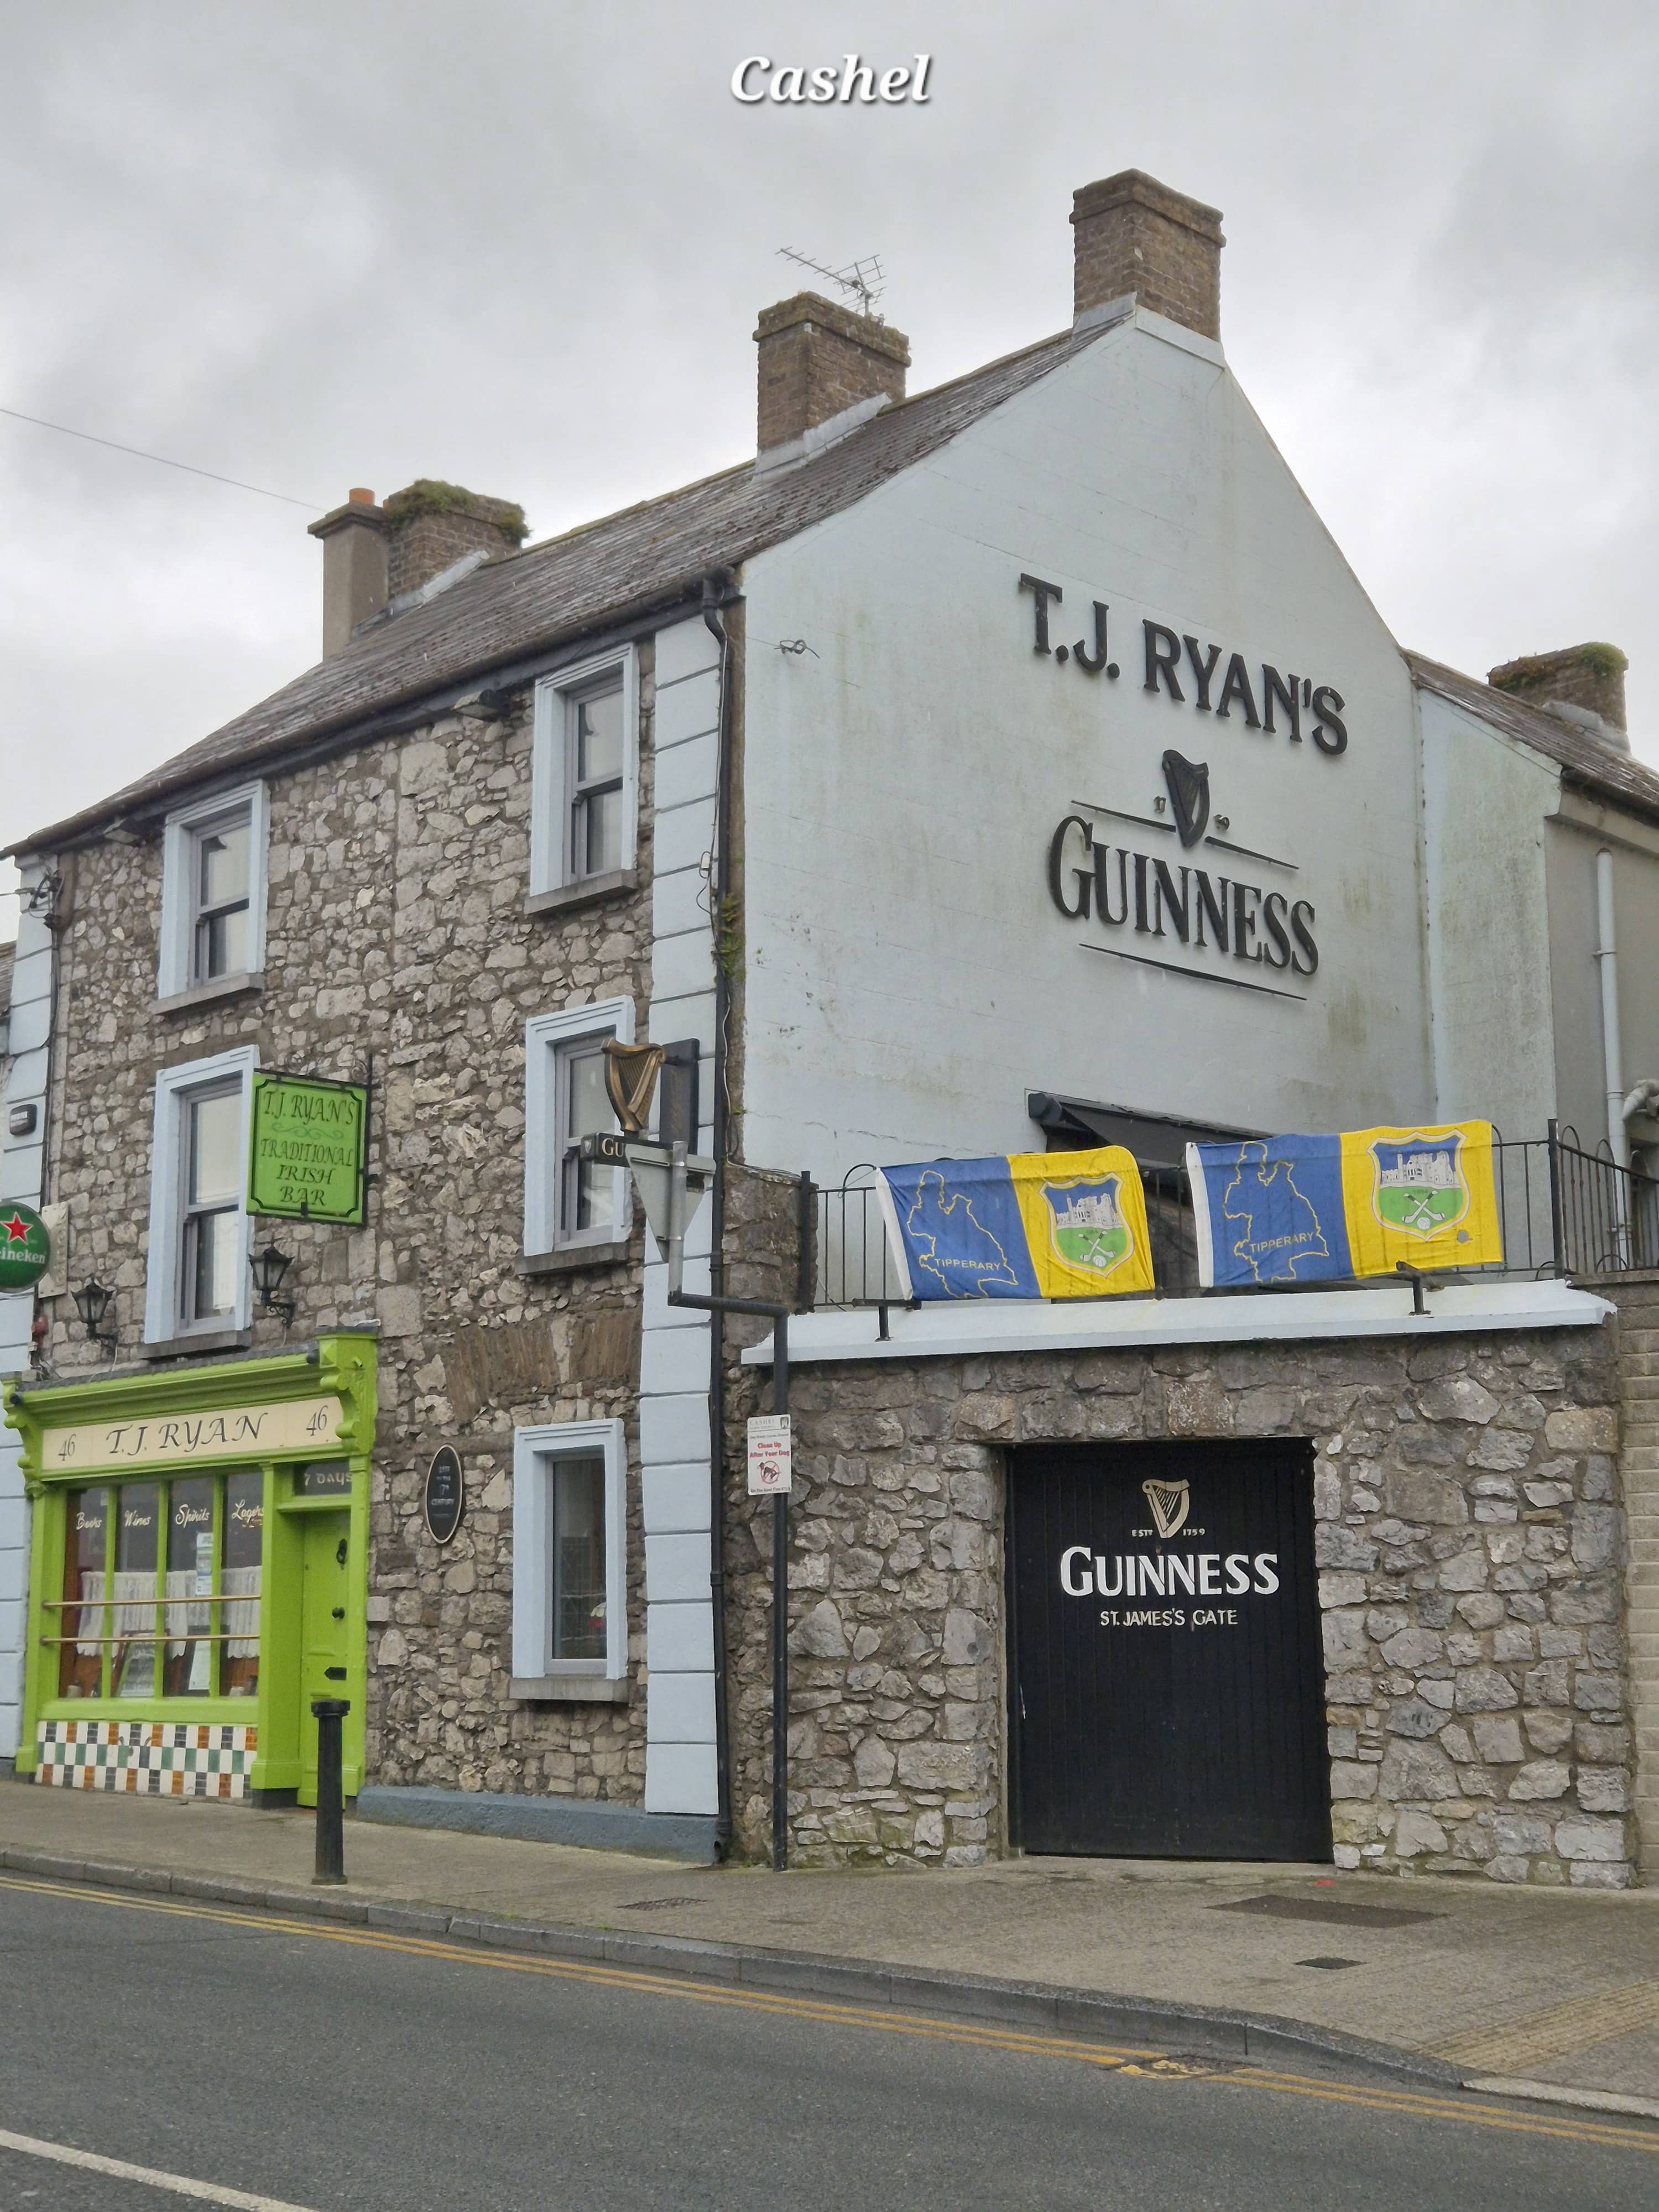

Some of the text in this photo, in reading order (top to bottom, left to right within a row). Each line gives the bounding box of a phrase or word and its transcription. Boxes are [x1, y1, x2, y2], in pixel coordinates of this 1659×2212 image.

[1019, 572, 1348, 756] T.J. RYAN'S
[1050, 815, 1319, 976] GUINNESS
[290, 1094, 356, 1125] RYAN'S
[260, 1138, 354, 1167] TRADITIONAL
[276, 1164, 336, 1185] IRISH
[280, 1186, 326, 1206] BAR
[1249, 1232, 1313, 1253] TIPPERARY
[935, 1259, 1000, 1271] TIPPERARY
[306, 1405, 329, 1437] 46
[106, 1412, 269, 1456] T.J. RYAN
[58, 1433, 76, 1461] 46
[304, 1472, 311, 1486] 7
[124, 1510, 152, 1527] Wines
[175, 1504, 210, 1528] Spirits
[1182, 1528, 1206, 1536] 1759
[1060, 1546, 1280, 1597] GUINNESS
[1100, 1608, 1238, 1627] ST. JAMES'S GATE
